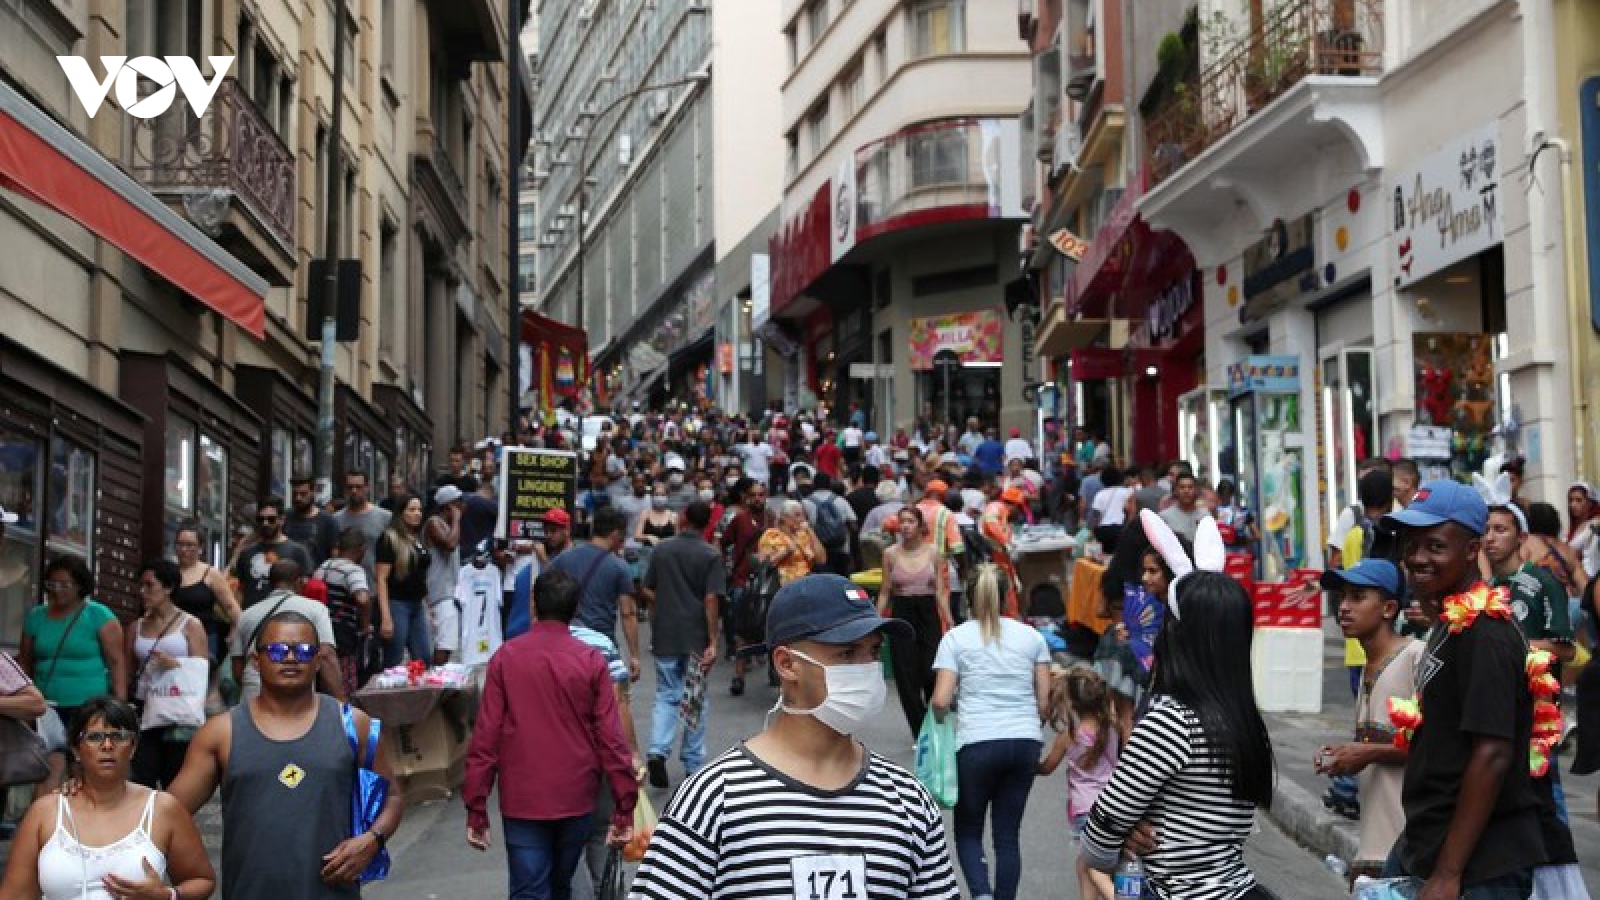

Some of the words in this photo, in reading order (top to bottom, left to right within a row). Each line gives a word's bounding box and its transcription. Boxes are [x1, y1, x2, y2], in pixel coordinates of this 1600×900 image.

[516, 453, 537, 467] SEX
[540, 455, 568, 469] SHOP
[517, 478, 565, 493] LINGERIE
[516, 495, 566, 509] REVENDA
[474, 590, 487, 627] 7
[807, 869, 858, 899] 171
